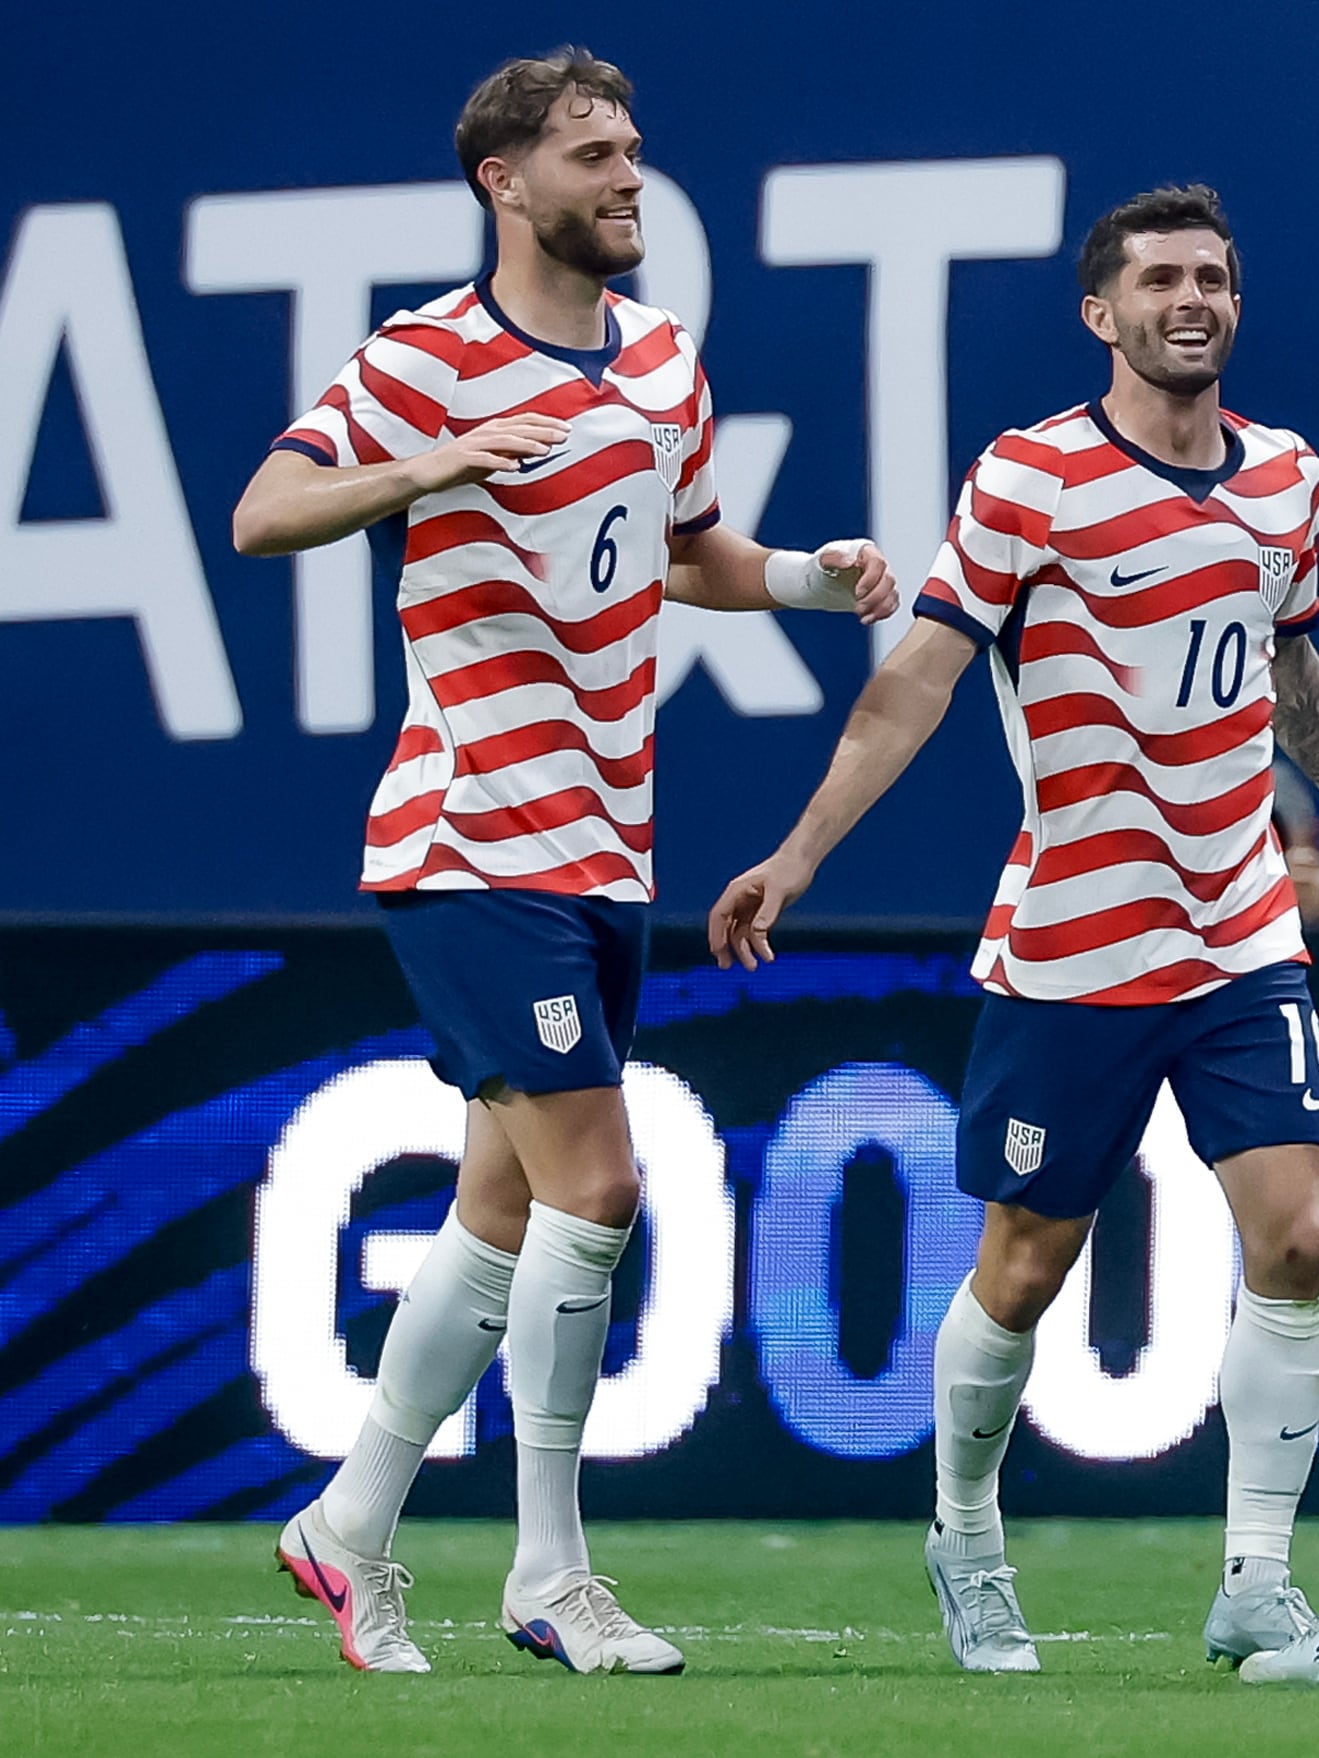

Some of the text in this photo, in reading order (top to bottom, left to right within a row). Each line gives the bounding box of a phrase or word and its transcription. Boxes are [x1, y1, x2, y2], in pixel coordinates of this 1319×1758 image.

[653, 427, 680, 453] USA
[590, 504, 628, 593] 6
[1262, 550, 1290, 577] USA
[1175, 620, 1247, 708] 10
[538, 999, 573, 1022] USA
[1011, 1122, 1042, 1146] USA
